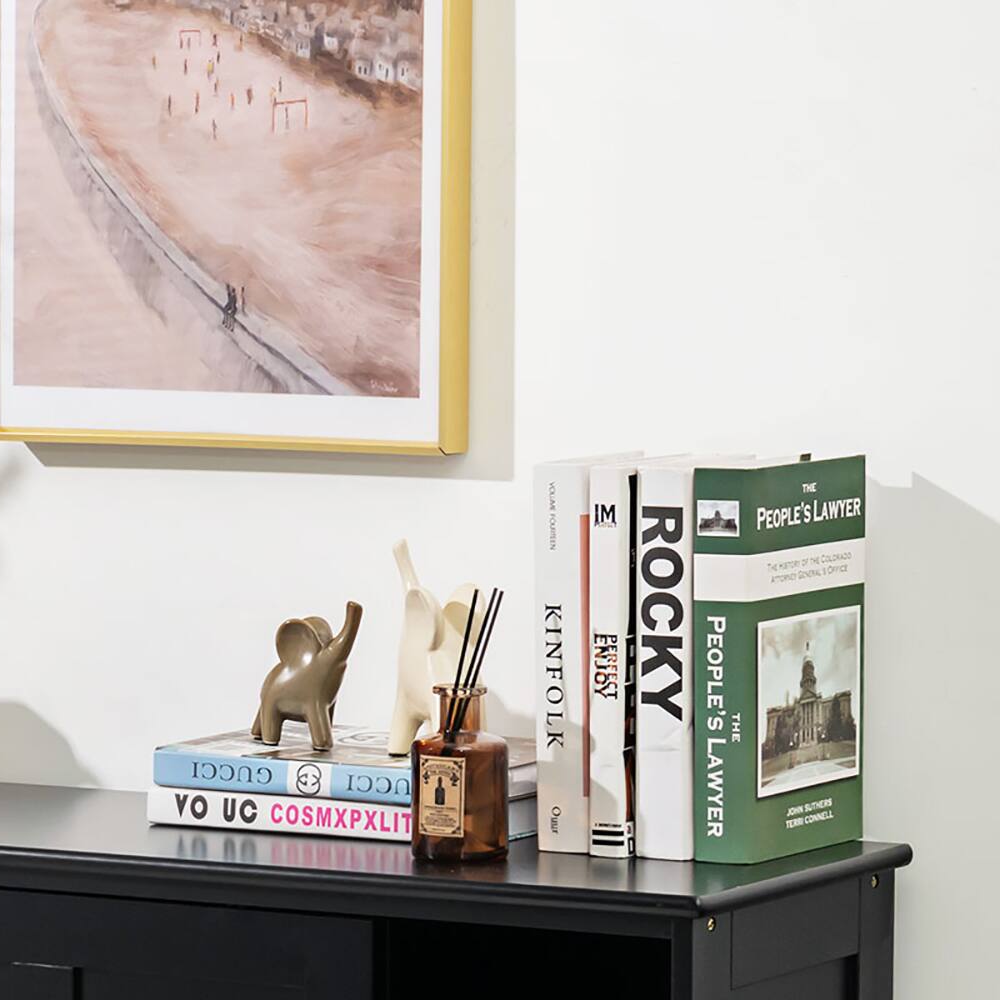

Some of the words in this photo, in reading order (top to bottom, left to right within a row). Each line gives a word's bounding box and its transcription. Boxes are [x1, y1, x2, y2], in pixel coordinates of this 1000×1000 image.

[802, 483, 817, 493] THE
[594, 504, 616, 523] IM
[757, 502, 812, 530] PEOPLE'S
[814, 498, 861, 521] LAWYER
[640, 505, 684, 722] ROCKY
[545, 604, 564, 748] KINFOLK
[594, 633, 608, 699] ENJOY
[607, 634, 618, 700] PERFECT
[706, 616, 727, 731] PEOPLE'S
[731, 712, 741, 742] THE
[192, 761, 273, 785] GUCCI
[346, 773, 411, 796] UCCI
[706, 737, 727, 838] LAWYER
[785, 817, 804, 829] TERRI
[804, 810, 834, 824] CONNELL
[787, 805, 803, 816] JOHN
[804, 798, 832, 812] SUTHERS
